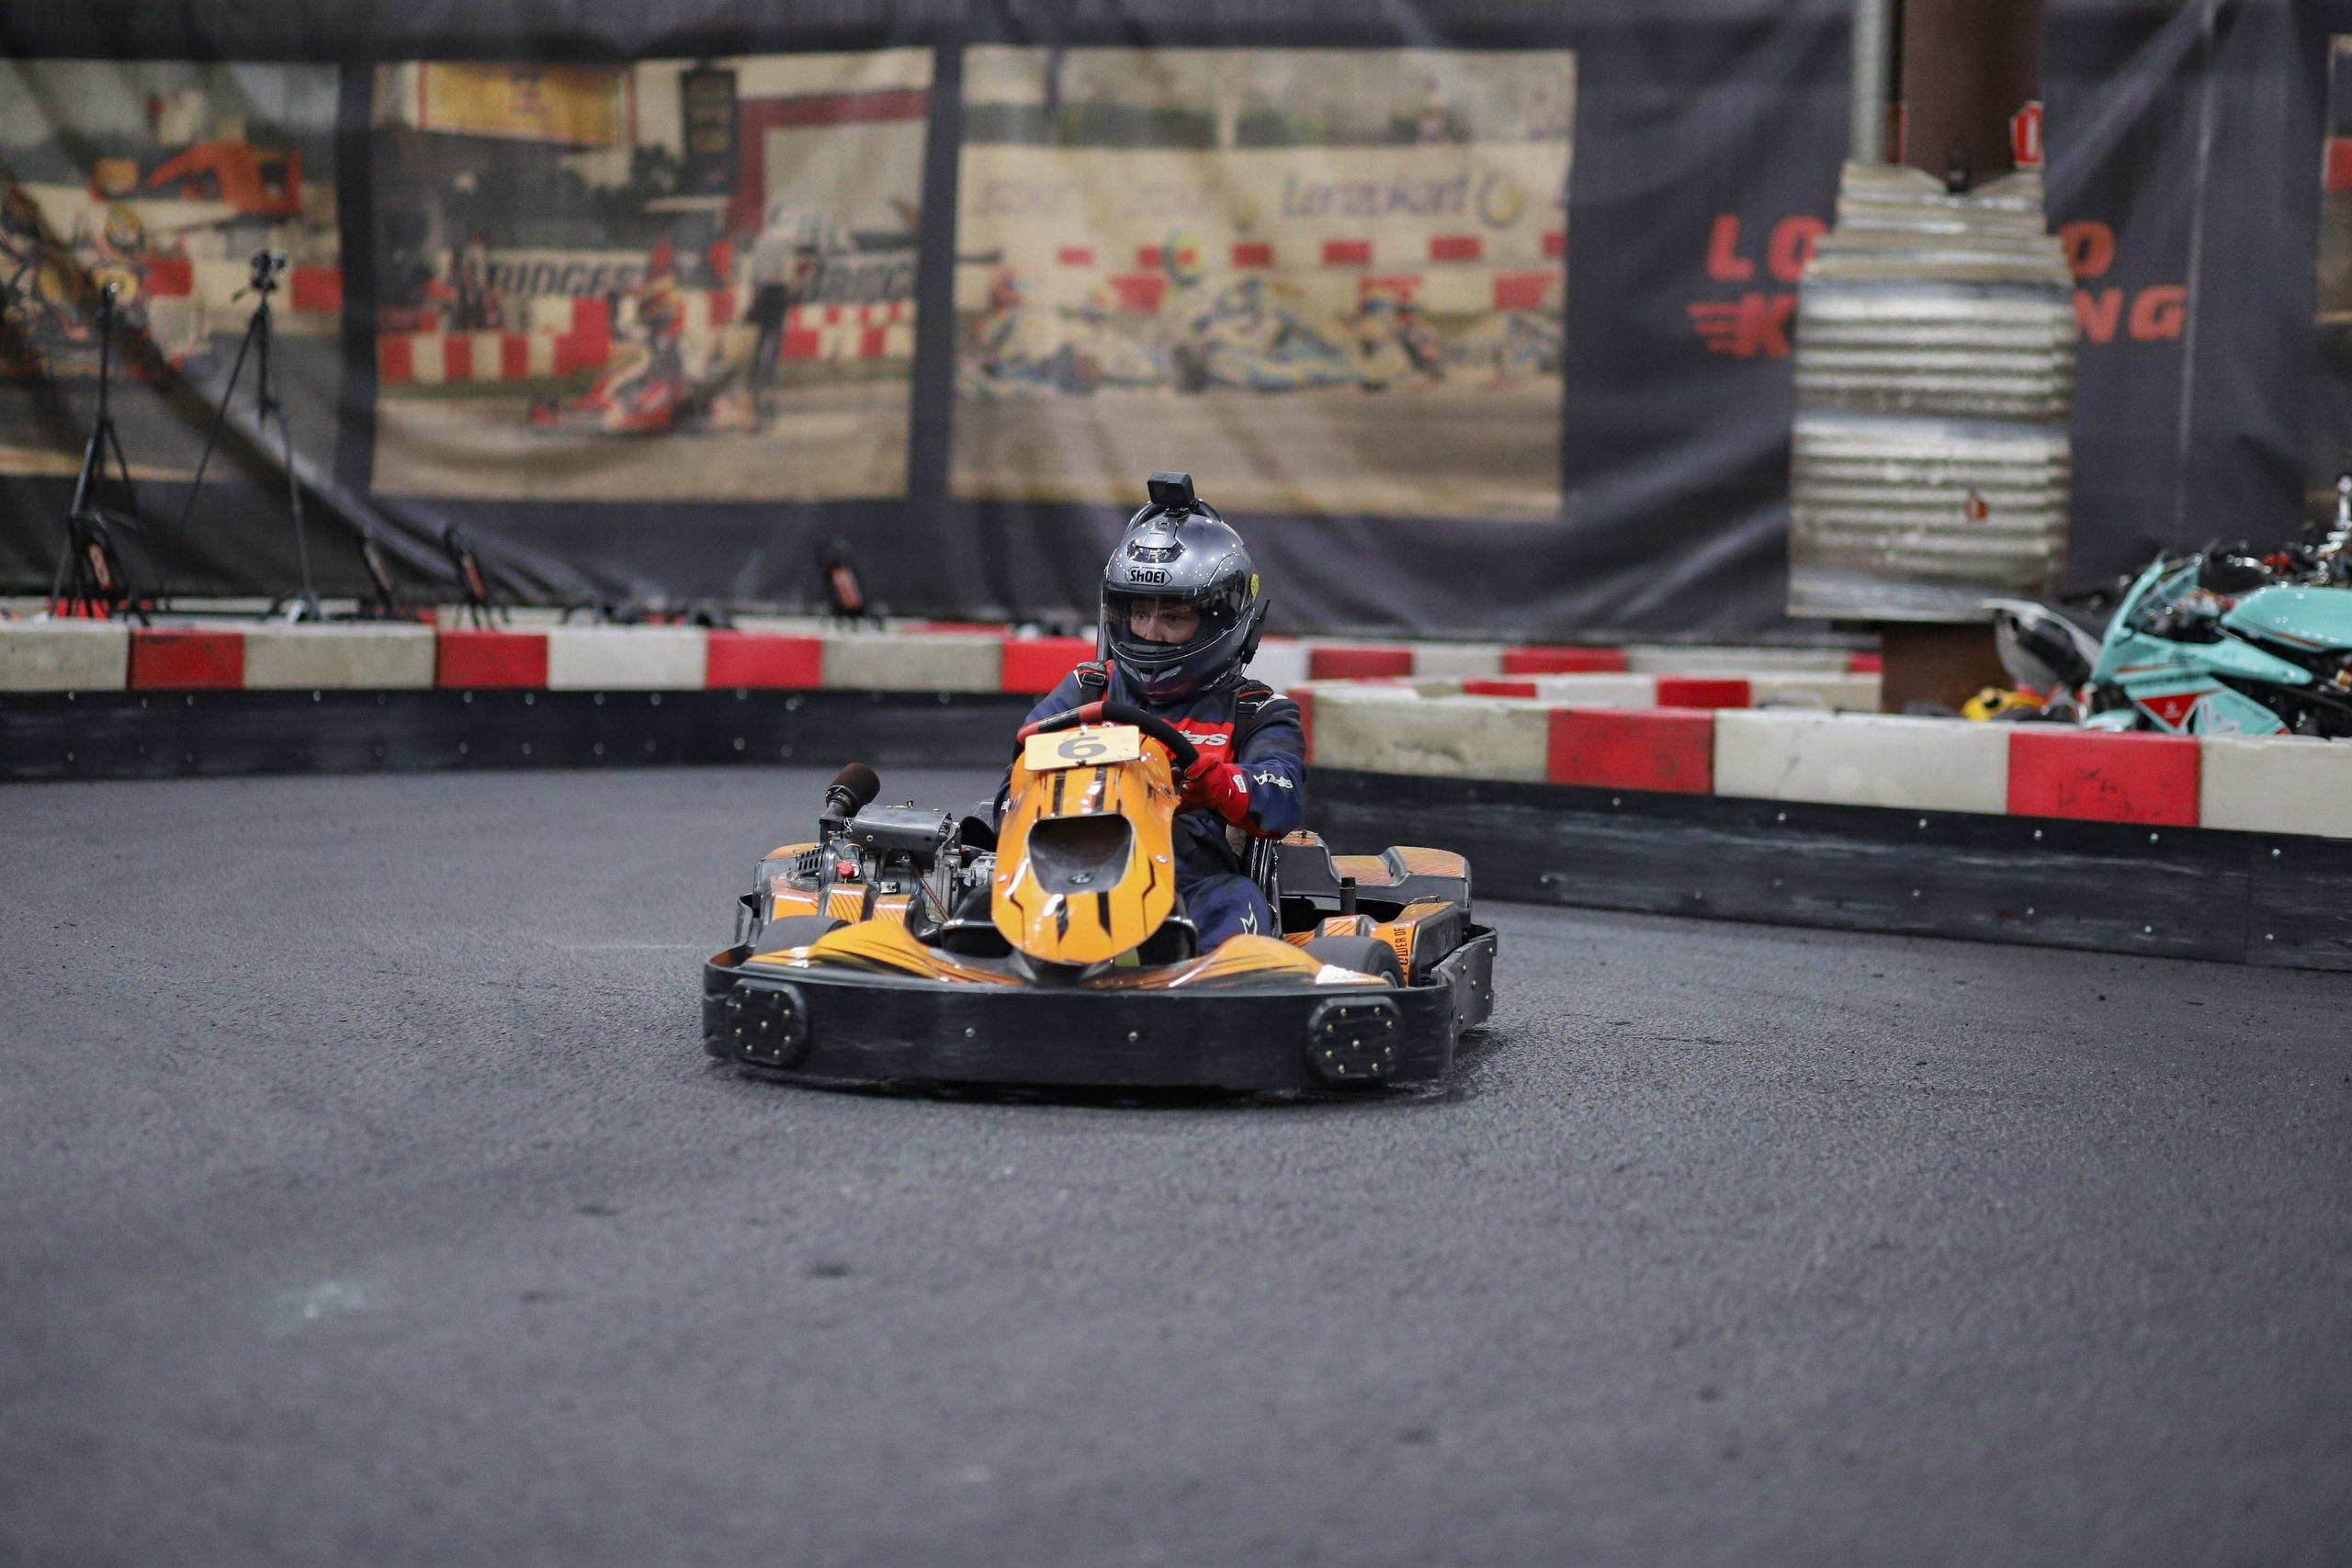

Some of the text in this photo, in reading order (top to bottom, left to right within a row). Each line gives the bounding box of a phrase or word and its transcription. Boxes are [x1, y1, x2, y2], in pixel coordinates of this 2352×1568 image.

[1057, 736, 1107, 760] 6
[1393, 927, 1408, 976] OWER OF
